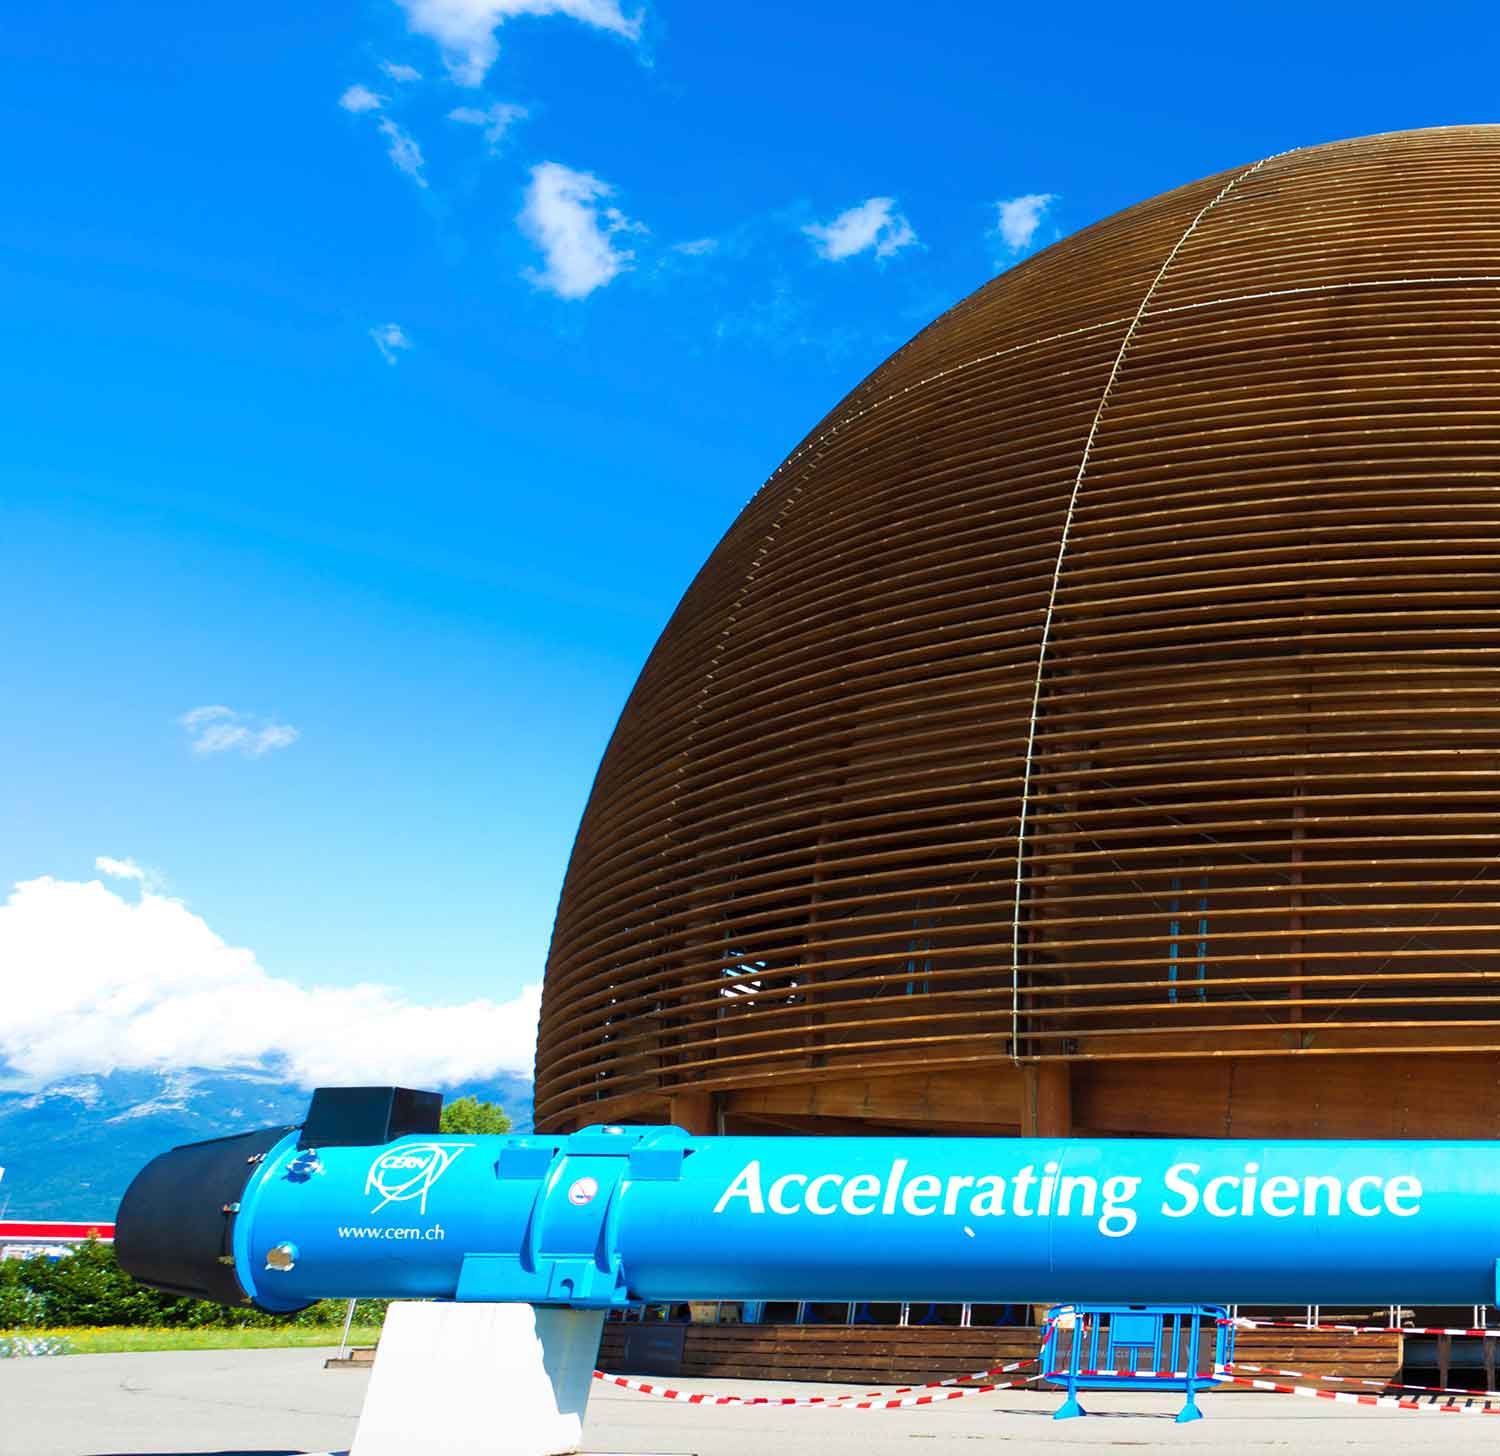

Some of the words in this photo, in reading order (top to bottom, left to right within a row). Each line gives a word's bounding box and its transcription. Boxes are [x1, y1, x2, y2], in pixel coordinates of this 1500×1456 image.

[380, 1155, 432, 1169] CERN
[712, 1159, 1143, 1238] Accelerating
[1160, 1161, 1424, 1217] Science
[337, 1223, 445, 1241] www.cern.ch
